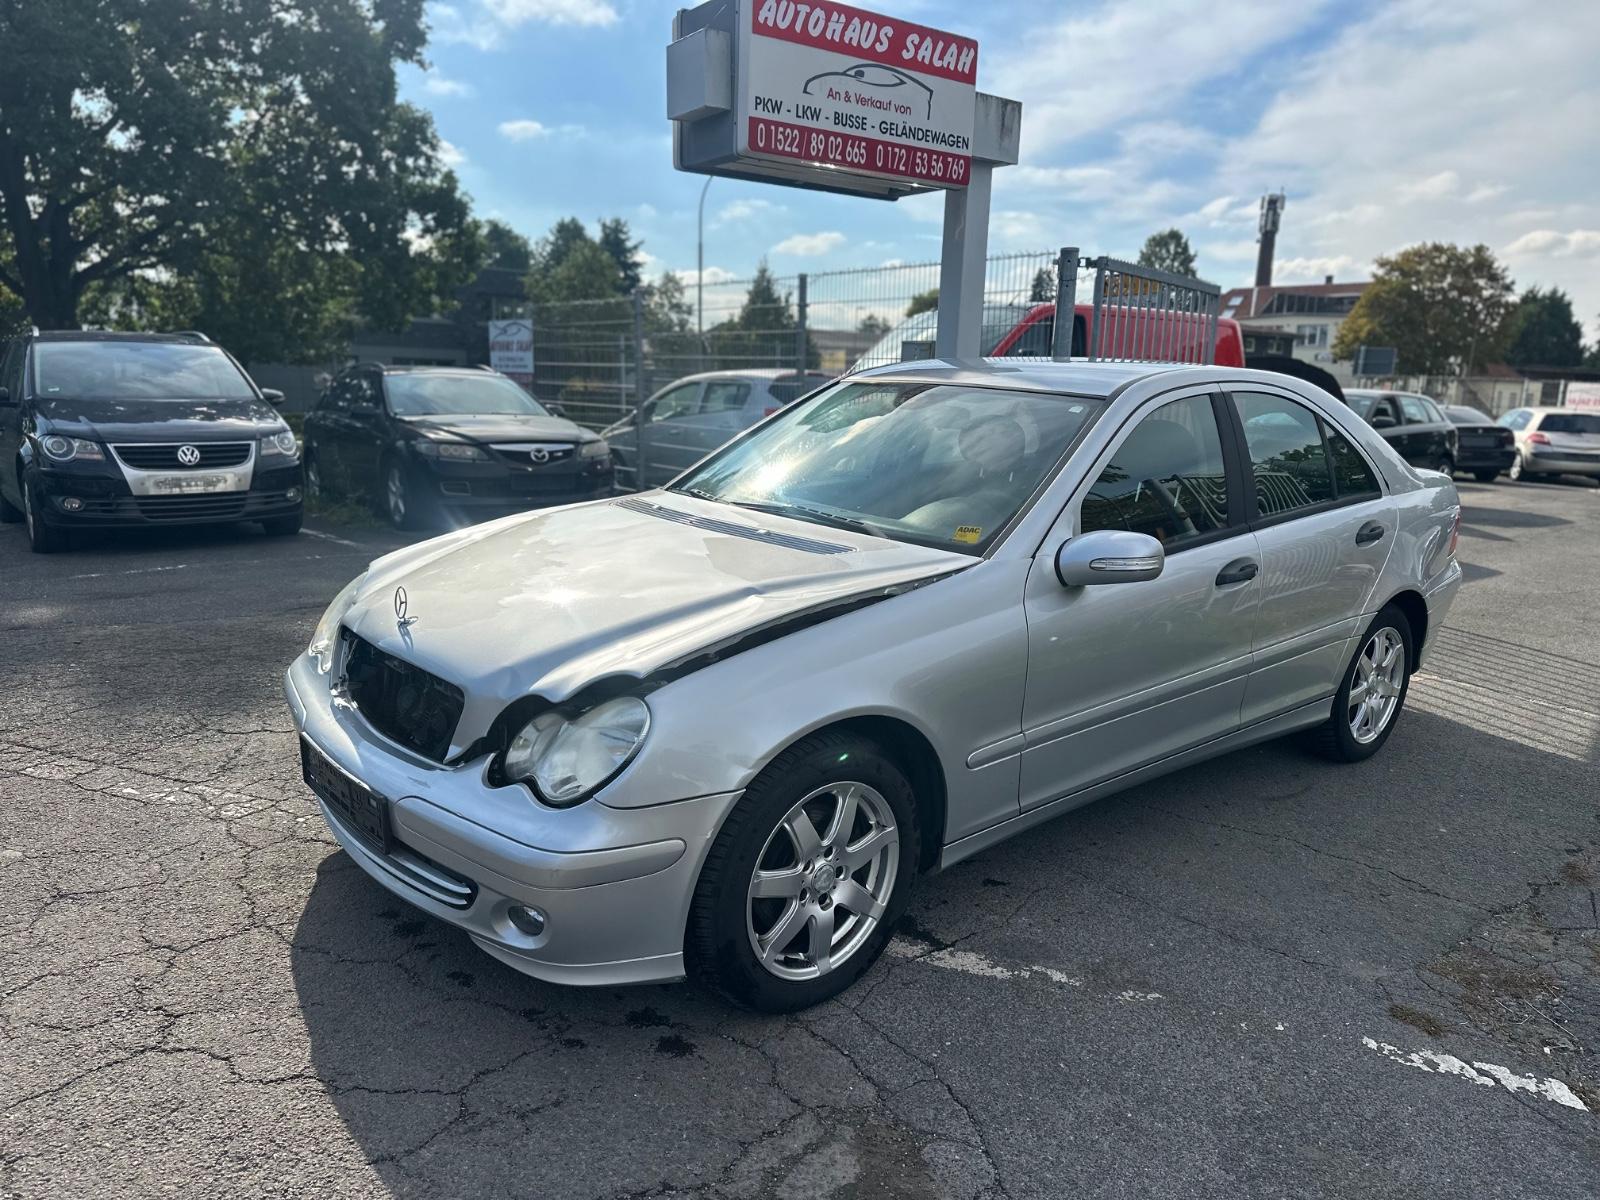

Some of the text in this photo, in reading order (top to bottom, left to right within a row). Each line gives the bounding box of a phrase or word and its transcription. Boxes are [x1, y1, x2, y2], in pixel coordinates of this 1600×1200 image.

[758, 0, 975, 74] AUTOHAUS SALAH
[827, 87, 912, 115] An & Verkauf von
[755, 96, 783, 115] PKW
[795, 104, 822, 122] LKW
[833, 111, 867, 131] BUSSE
[879, 119, 969, 150] GELÄNDEWAGEN
[757, 123, 766, 148] 0
[770, 125, 799, 153] 1522
[810, 132, 825, 157] 89
[828, 136, 842, 160] 02
[846, 139, 867, 164] 665
[876, 144, 884, 167] 0
[888, 147, 906, 171] 172
[915, 151, 928, 175] 53
[931, 154, 944, 177] 56
[946, 157, 965, 180] 769
[957, 526, 981, 534] ADAC
